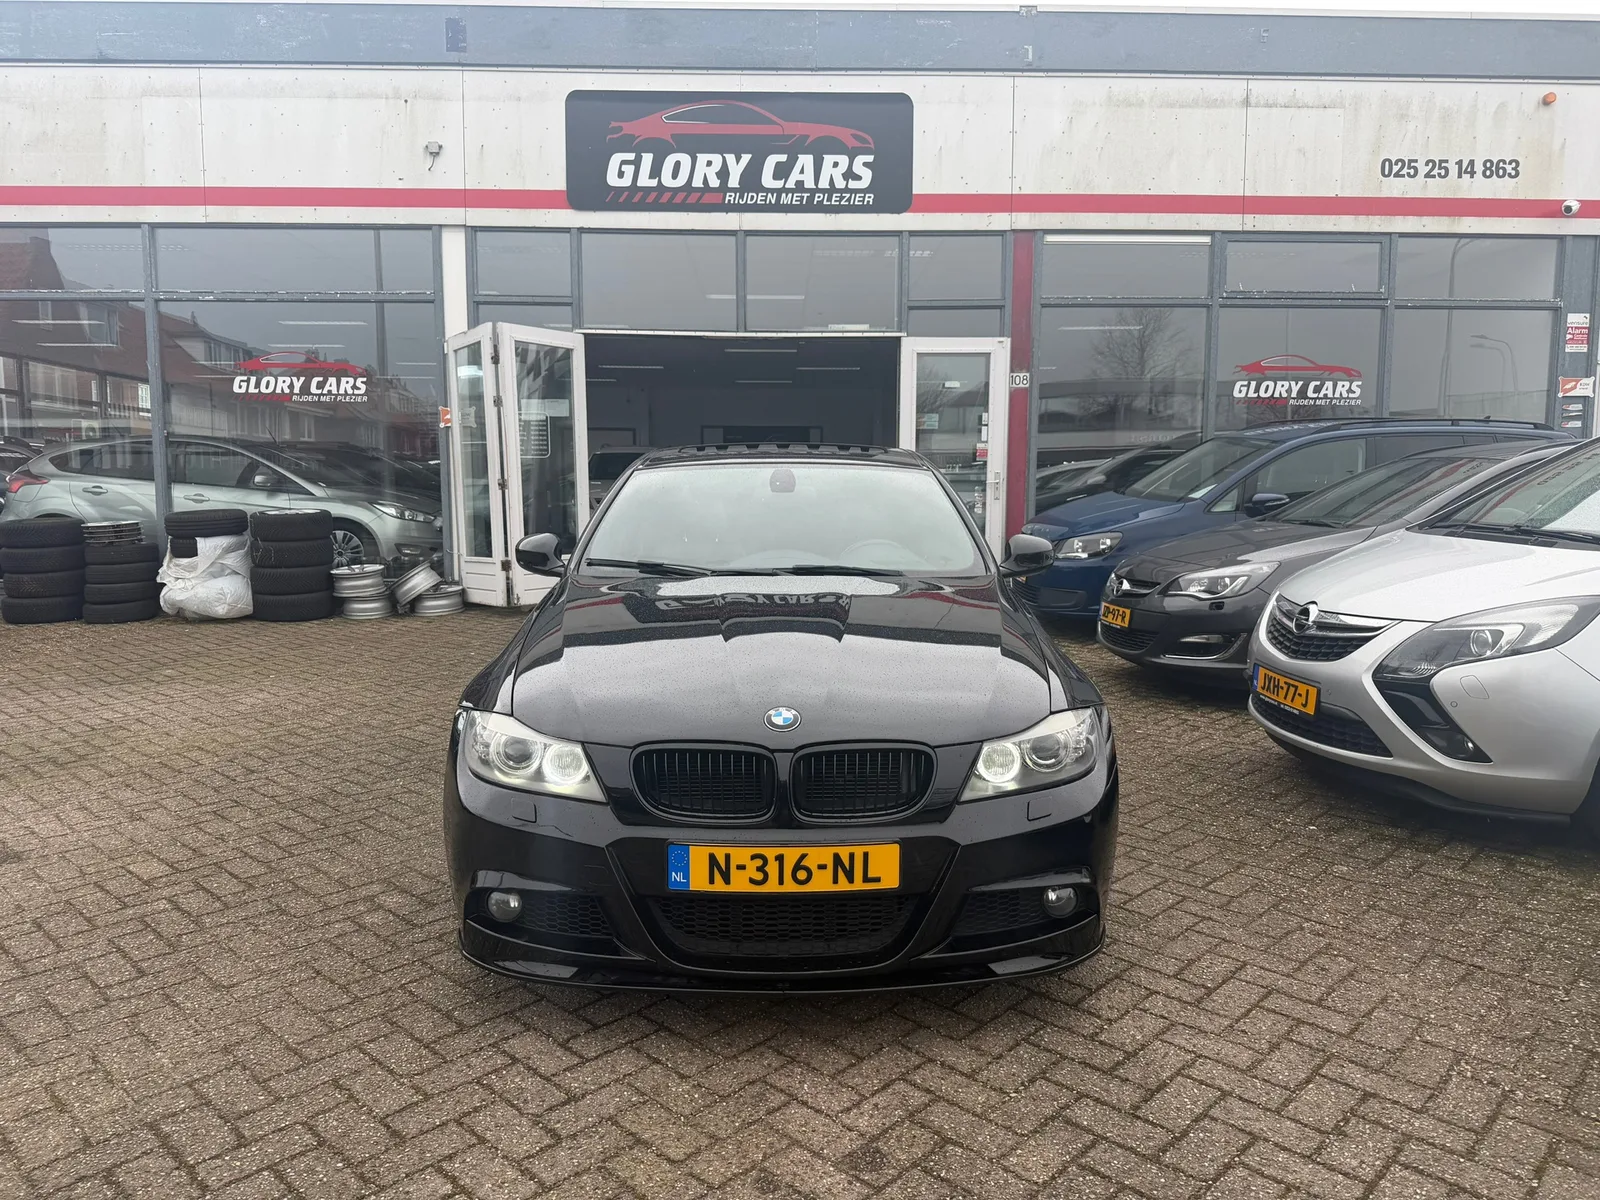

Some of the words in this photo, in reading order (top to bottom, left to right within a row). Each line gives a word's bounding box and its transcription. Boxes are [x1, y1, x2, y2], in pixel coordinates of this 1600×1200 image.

[606, 153, 752, 188] GLORY
[761, 154, 875, 189] CARS
[1380, 158, 1419, 178] 025
[1423, 158, 1450, 179] 25
[1454, 159, 1477, 179] 14
[1481, 158, 1521, 179] 863
[725, 192, 777, 205] RIJDEN
[780, 193, 811, 205] MET
[813, 193, 875, 206] PLEZIER
[232, 375, 306, 394] GLORY
[309, 376, 367, 395] CARS
[1010, 374, 1029, 386] 108
[1232, 380, 1304, 398] GLORY
[1306, 381, 1363, 398] CARS
[336, 395, 368, 403] PLEZIER
[1260, 672, 1310, 709] JXH-77-J
[671, 871, 687, 882] NL
[708, 851, 882, 886] N-316-NL
